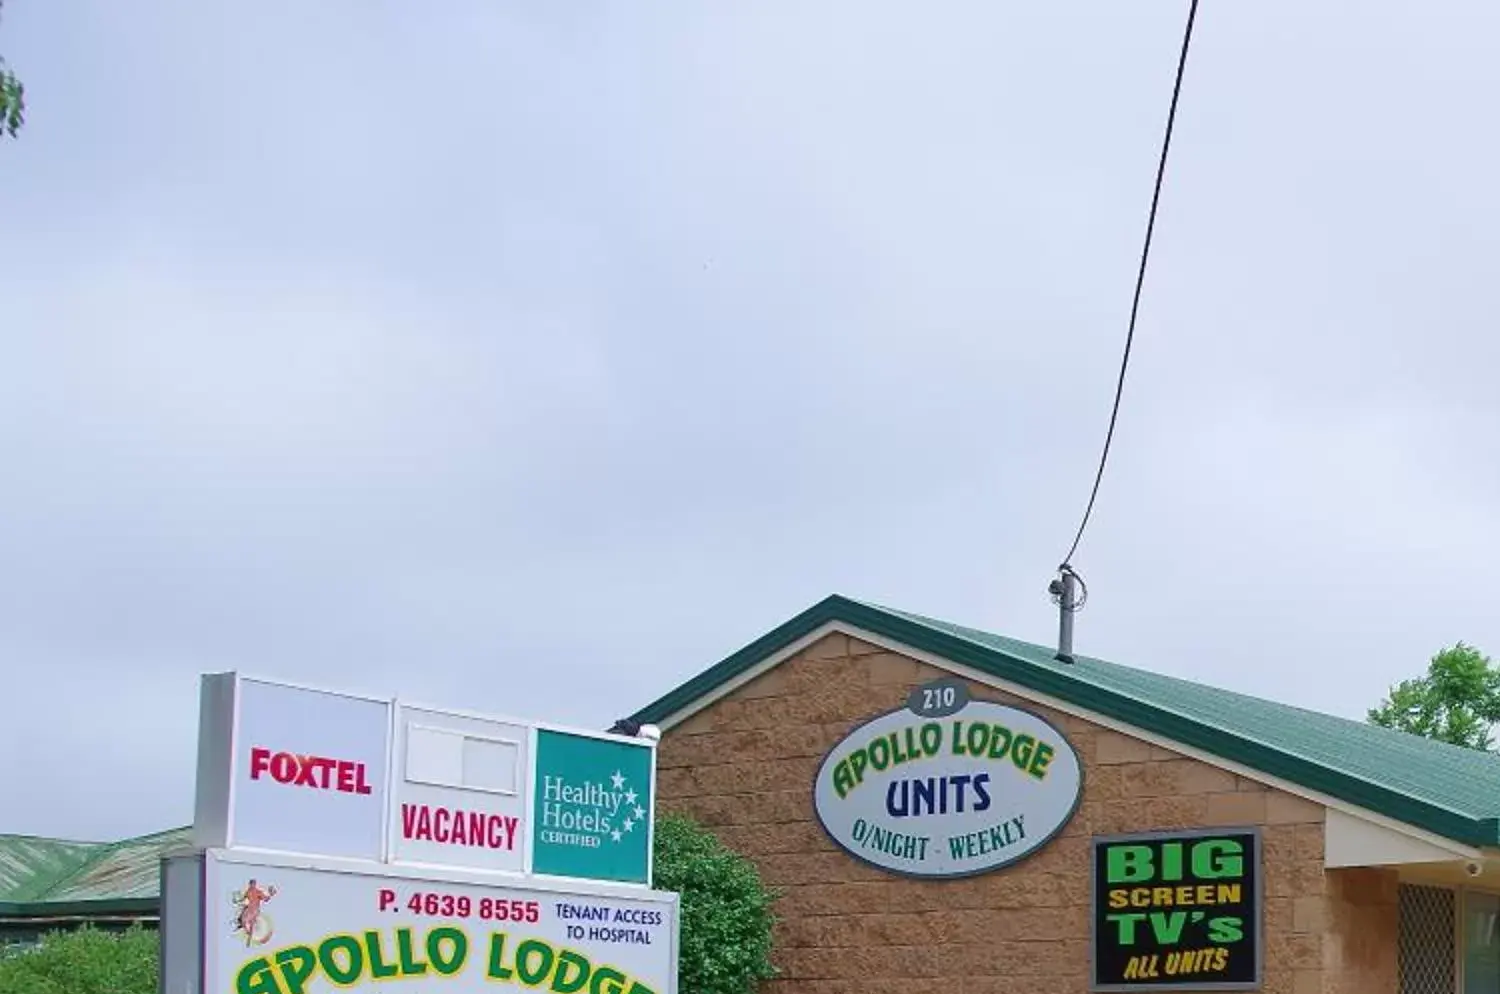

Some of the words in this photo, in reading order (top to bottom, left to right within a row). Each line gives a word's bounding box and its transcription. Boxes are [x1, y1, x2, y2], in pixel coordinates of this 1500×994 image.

[923, 688, 955, 709] 210
[250, 747, 372, 794] FOXTEL
[832, 722, 942, 799] APOLLO
[952, 722, 1055, 781] LODGE
[544, 775, 622, 816] Healthy
[886, 773, 991, 817] UNITS
[401, 803, 519, 851] VACANCY
[543, 801, 610, 833] Hotels
[541, 830, 600, 848] CERTIFIED
[853, 819, 929, 860] O/NIGHT
[948, 815, 1026, 861] WEEKLY
[1107, 839, 1243, 883] BIG
[378, 890, 399, 912] P.
[407, 893, 472, 918] 4639
[479, 896, 539, 923] 8555
[1108, 884, 1241, 908] SCREEN
[556, 903, 609, 923] TENANT
[614, 908, 661, 925] ACCESS
[567, 925, 585, 940] TO
[588, 927, 651, 945] HOSPITAL
[1123, 954, 1158, 980] ALL
[1165, 948, 1229, 976] UNITS
